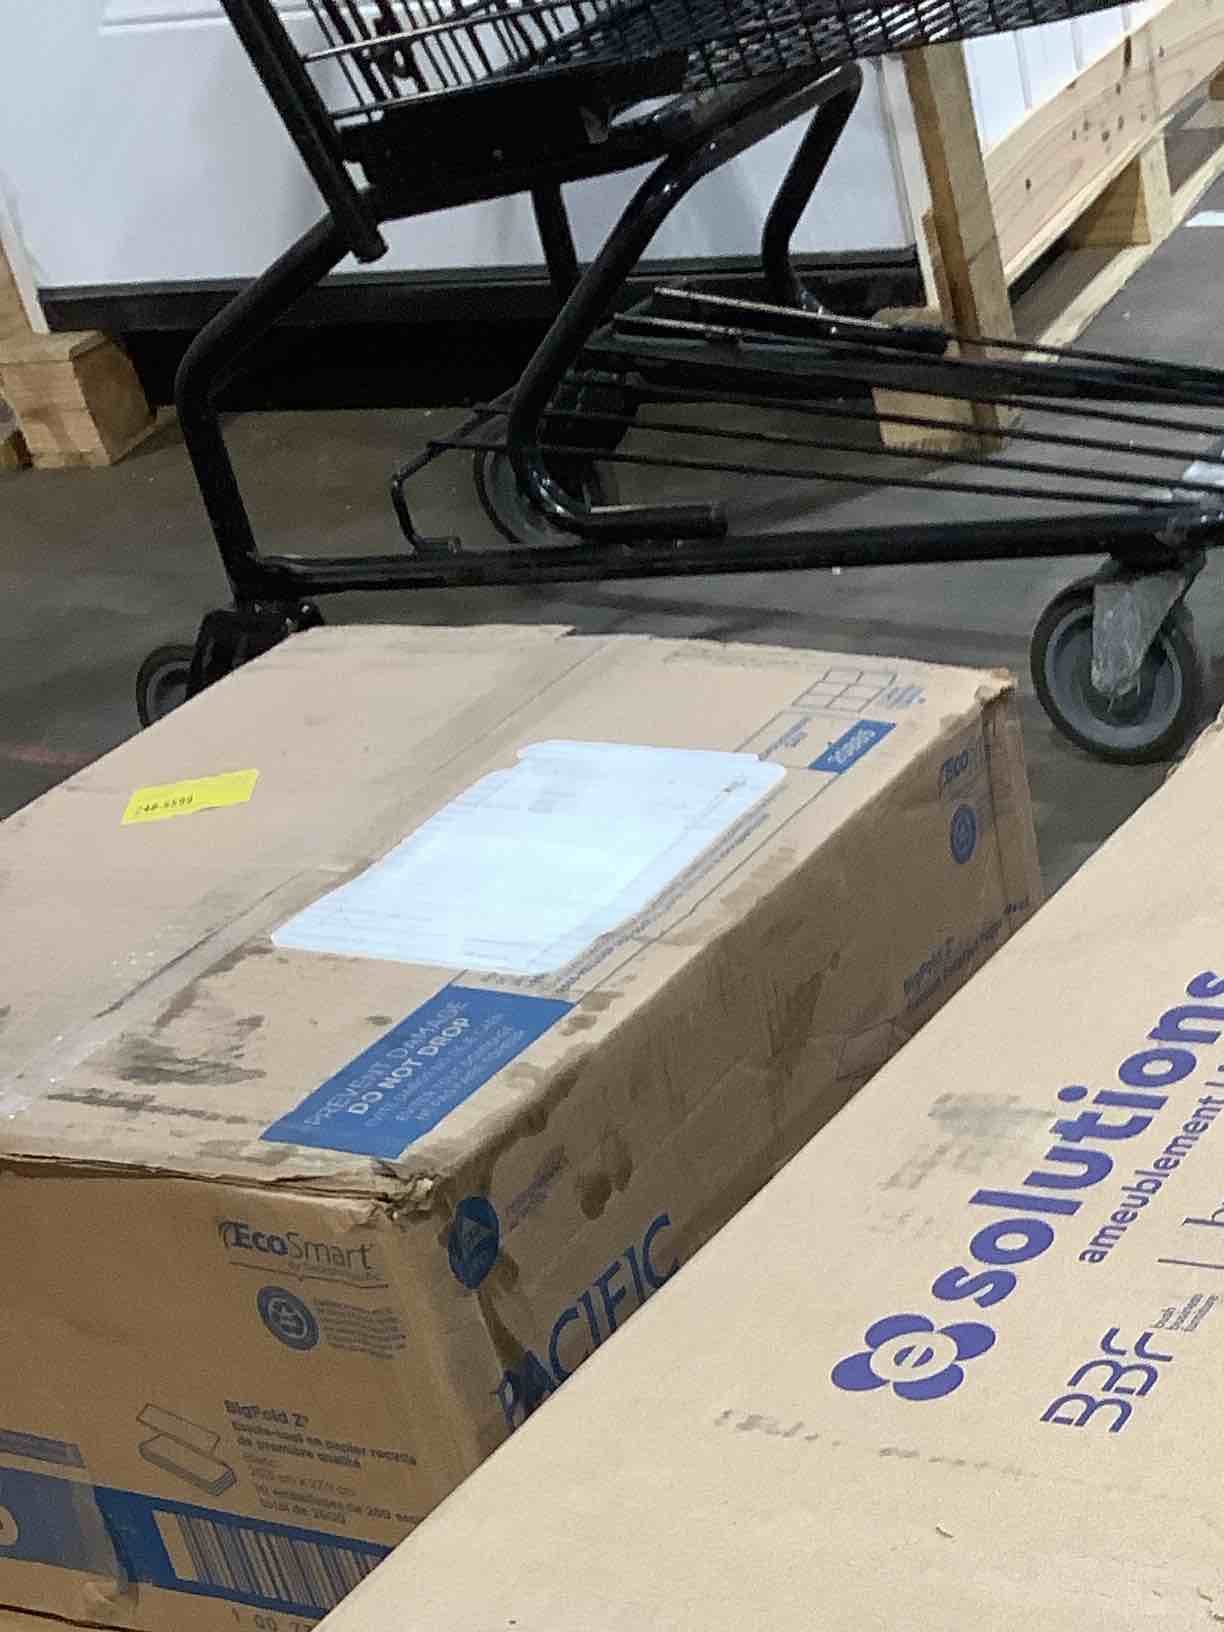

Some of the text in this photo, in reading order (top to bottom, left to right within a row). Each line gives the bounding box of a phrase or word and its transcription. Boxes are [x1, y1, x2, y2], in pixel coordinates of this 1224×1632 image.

[348, 1016, 471, 1116] DO NOT DROP
[230, 1222, 373, 1271] EcoSmart
